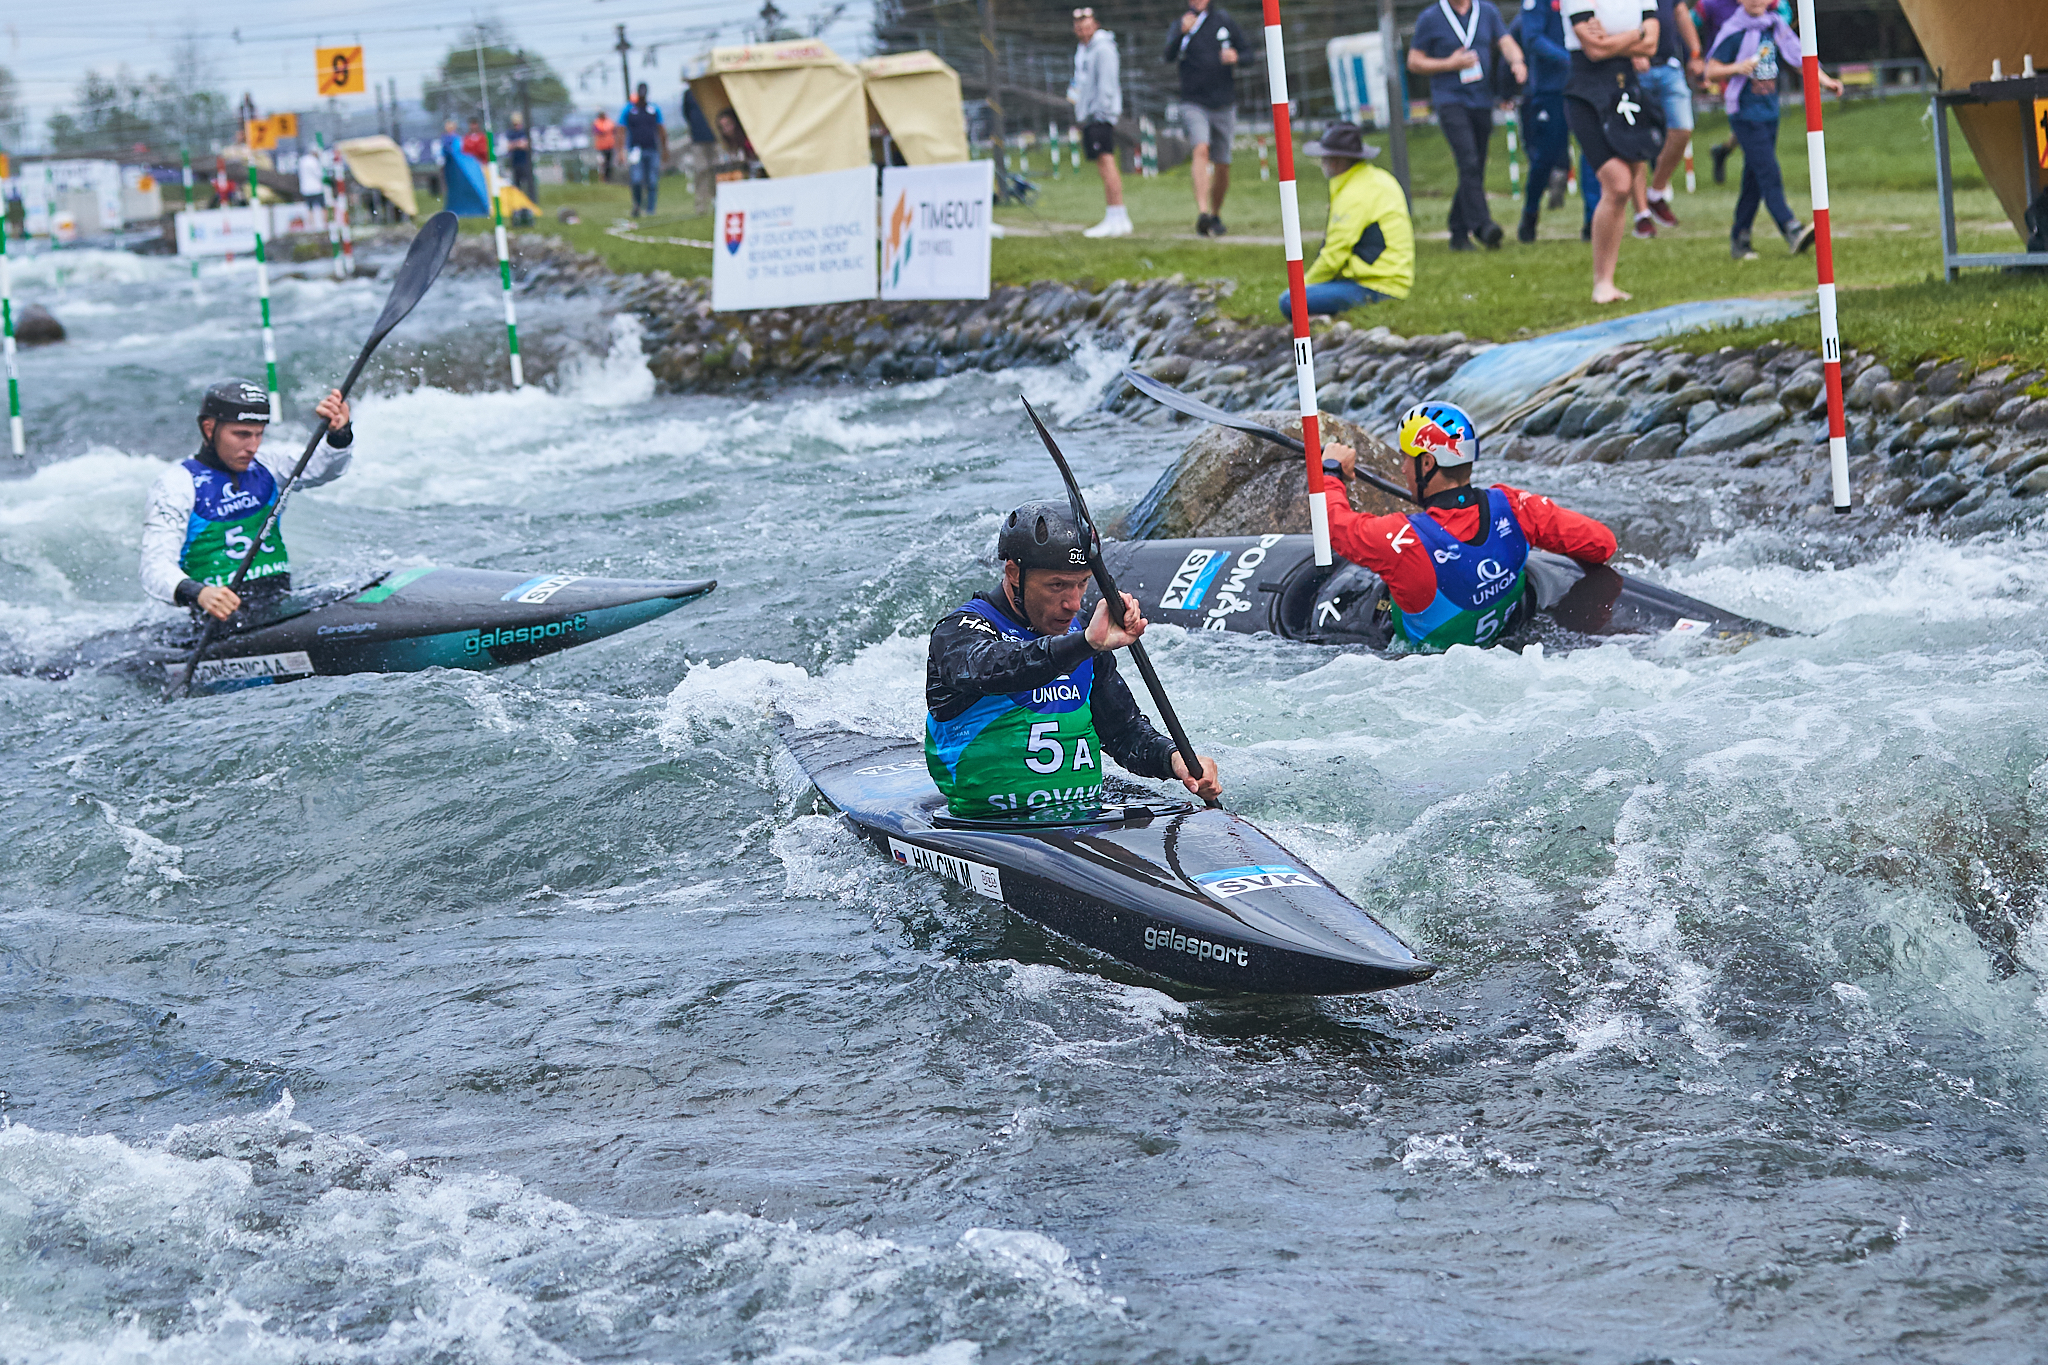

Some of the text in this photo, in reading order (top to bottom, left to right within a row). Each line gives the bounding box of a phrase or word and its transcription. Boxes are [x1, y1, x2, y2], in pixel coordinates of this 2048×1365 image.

[332, 54, 349, 86] 9
[920, 200, 983, 229] TIMEOUT
[1296, 342, 1307, 366] 11
[1826, 337, 1838, 359] 11
[216, 495, 261, 517] UNIQA
[225, 525, 253, 560] 5
[1165, 553, 1208, 604] SVK
[1472, 571, 1517, 606] UNIQA
[464, 613, 588, 656] galasport
[1032, 684, 1081, 704] UNIQA
[1024, 720, 1096, 775] 5 A
[1216, 874, 1312, 893] SVK
[1143, 926, 1249, 967] galasport
